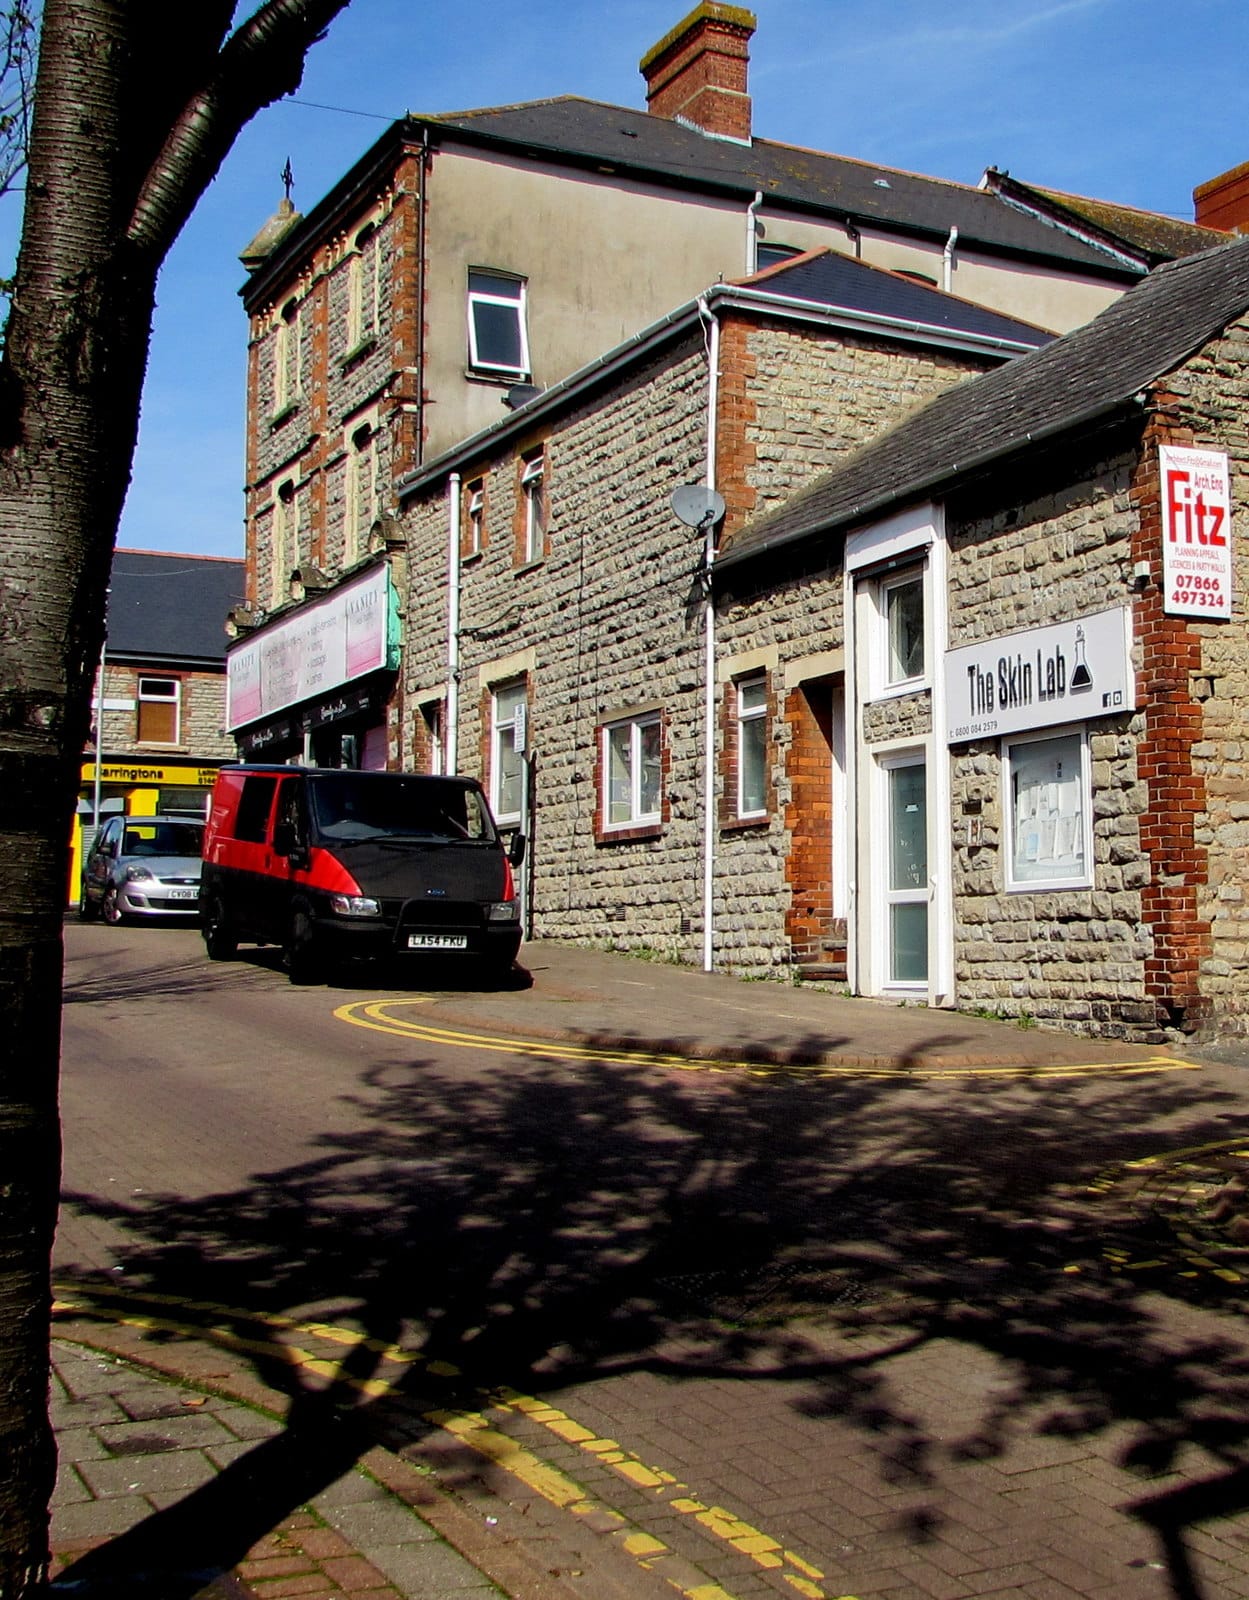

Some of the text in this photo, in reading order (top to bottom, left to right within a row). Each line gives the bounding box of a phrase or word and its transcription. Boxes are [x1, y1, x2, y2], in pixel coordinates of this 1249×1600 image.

[1167, 469, 1226, 547] Fitz
[1176, 574, 1220, 591] 07866
[1171, 590, 1224, 607] 497324
[967, 663, 994, 716] The
[1037, 644, 1066, 702] Lab
[94, 765, 164, 781] arringtons
[412, 935, 465, 947] LA54 FKU
